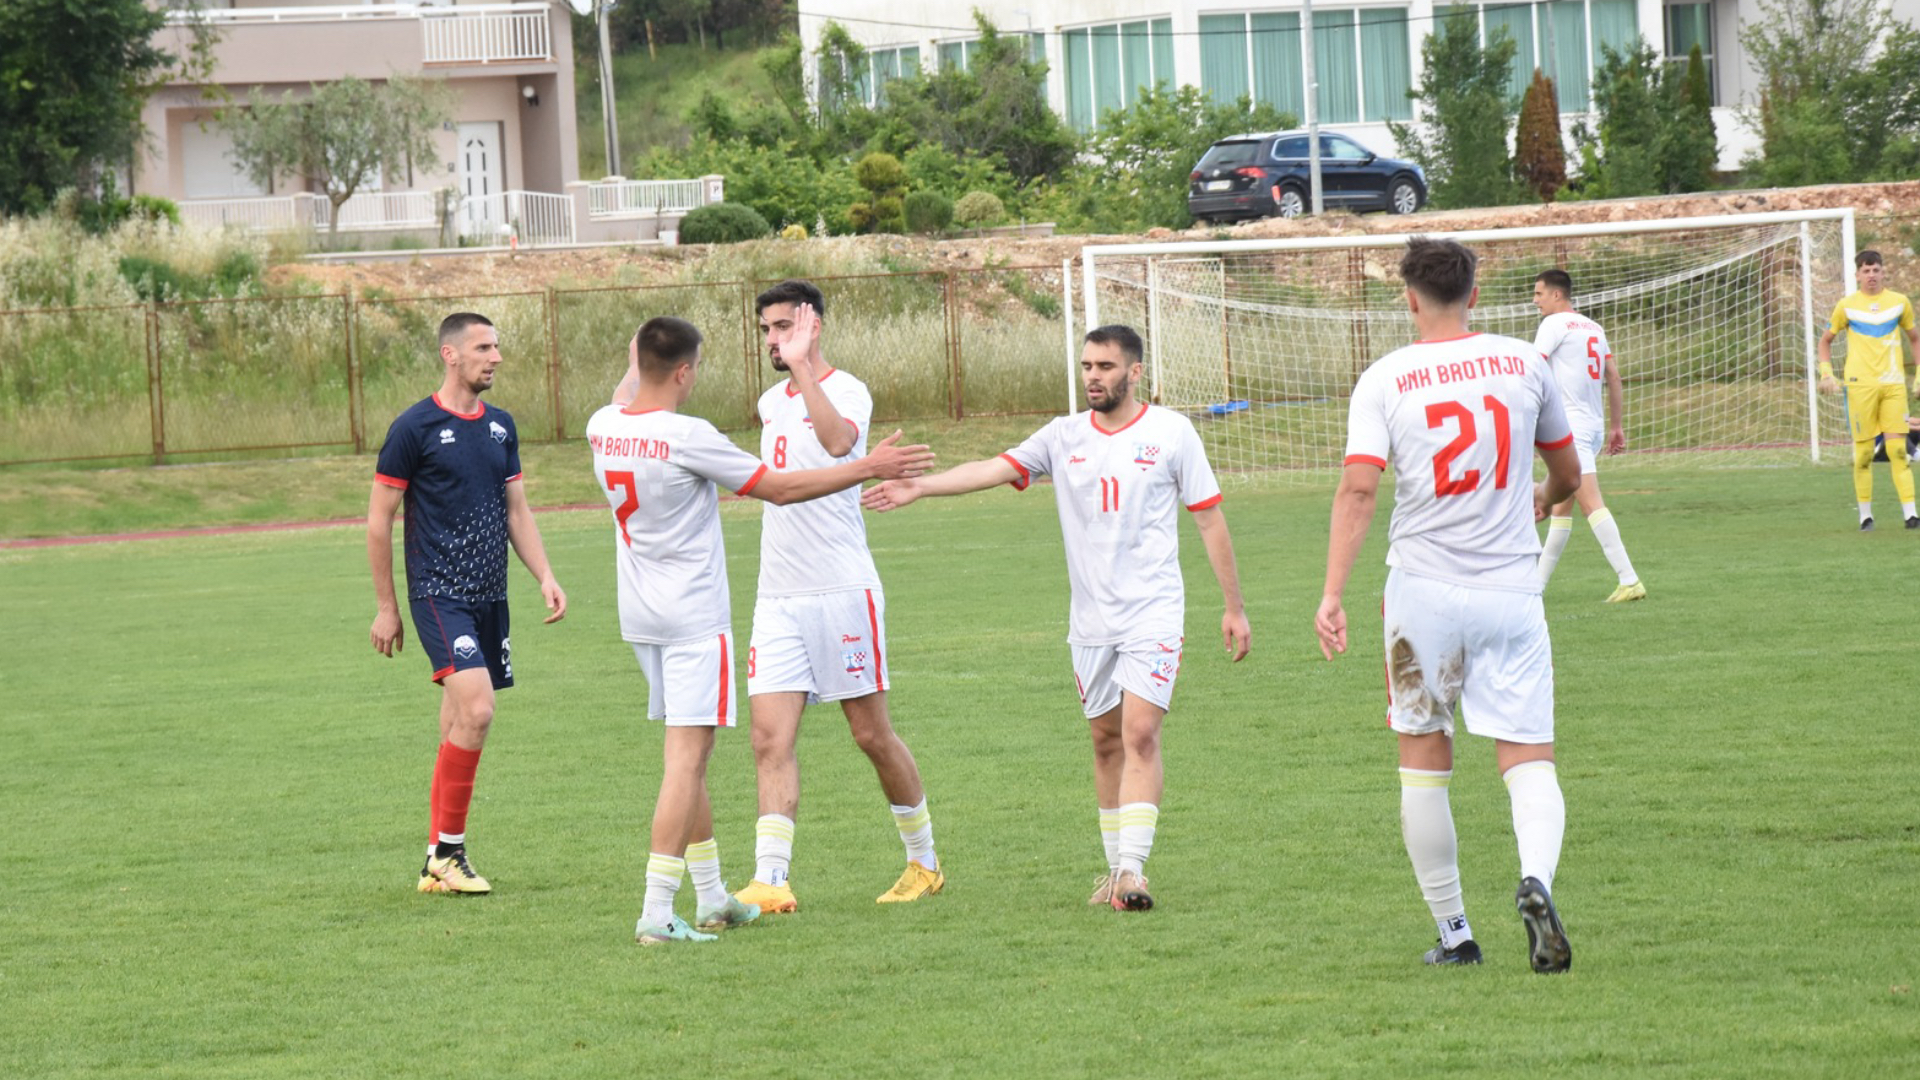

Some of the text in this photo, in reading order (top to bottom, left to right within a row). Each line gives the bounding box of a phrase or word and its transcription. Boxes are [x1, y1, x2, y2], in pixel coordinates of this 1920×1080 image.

[1436, 356, 1525, 384] BROTNJO
[1587, 336, 1601, 379] 5
[605, 436, 669, 460] BROTNJO
[774, 435, 787, 469] 8
[1425, 395, 1511, 499] 21
[604, 470, 639, 548] 7
[1100, 476, 1118, 512] 11
